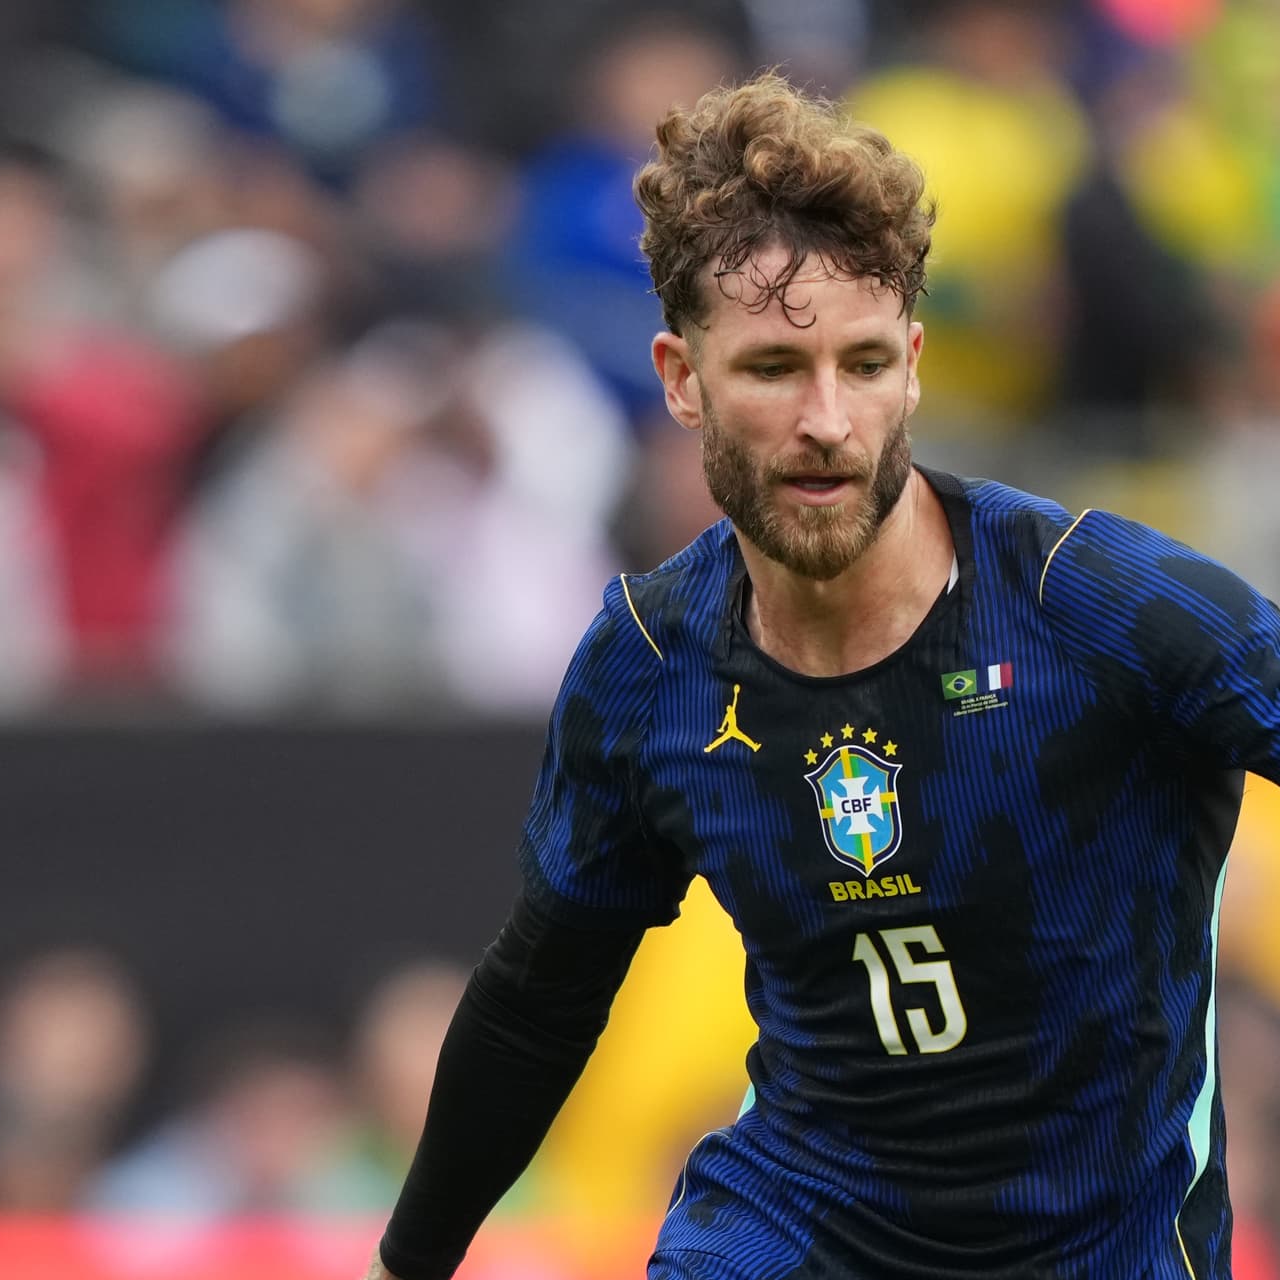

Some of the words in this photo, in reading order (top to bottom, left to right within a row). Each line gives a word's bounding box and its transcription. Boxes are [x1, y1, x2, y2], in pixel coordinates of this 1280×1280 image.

[841, 797, 872, 814] CBF
[828, 873, 922, 902] BRASIL
[852, 924, 968, 1056] 15
